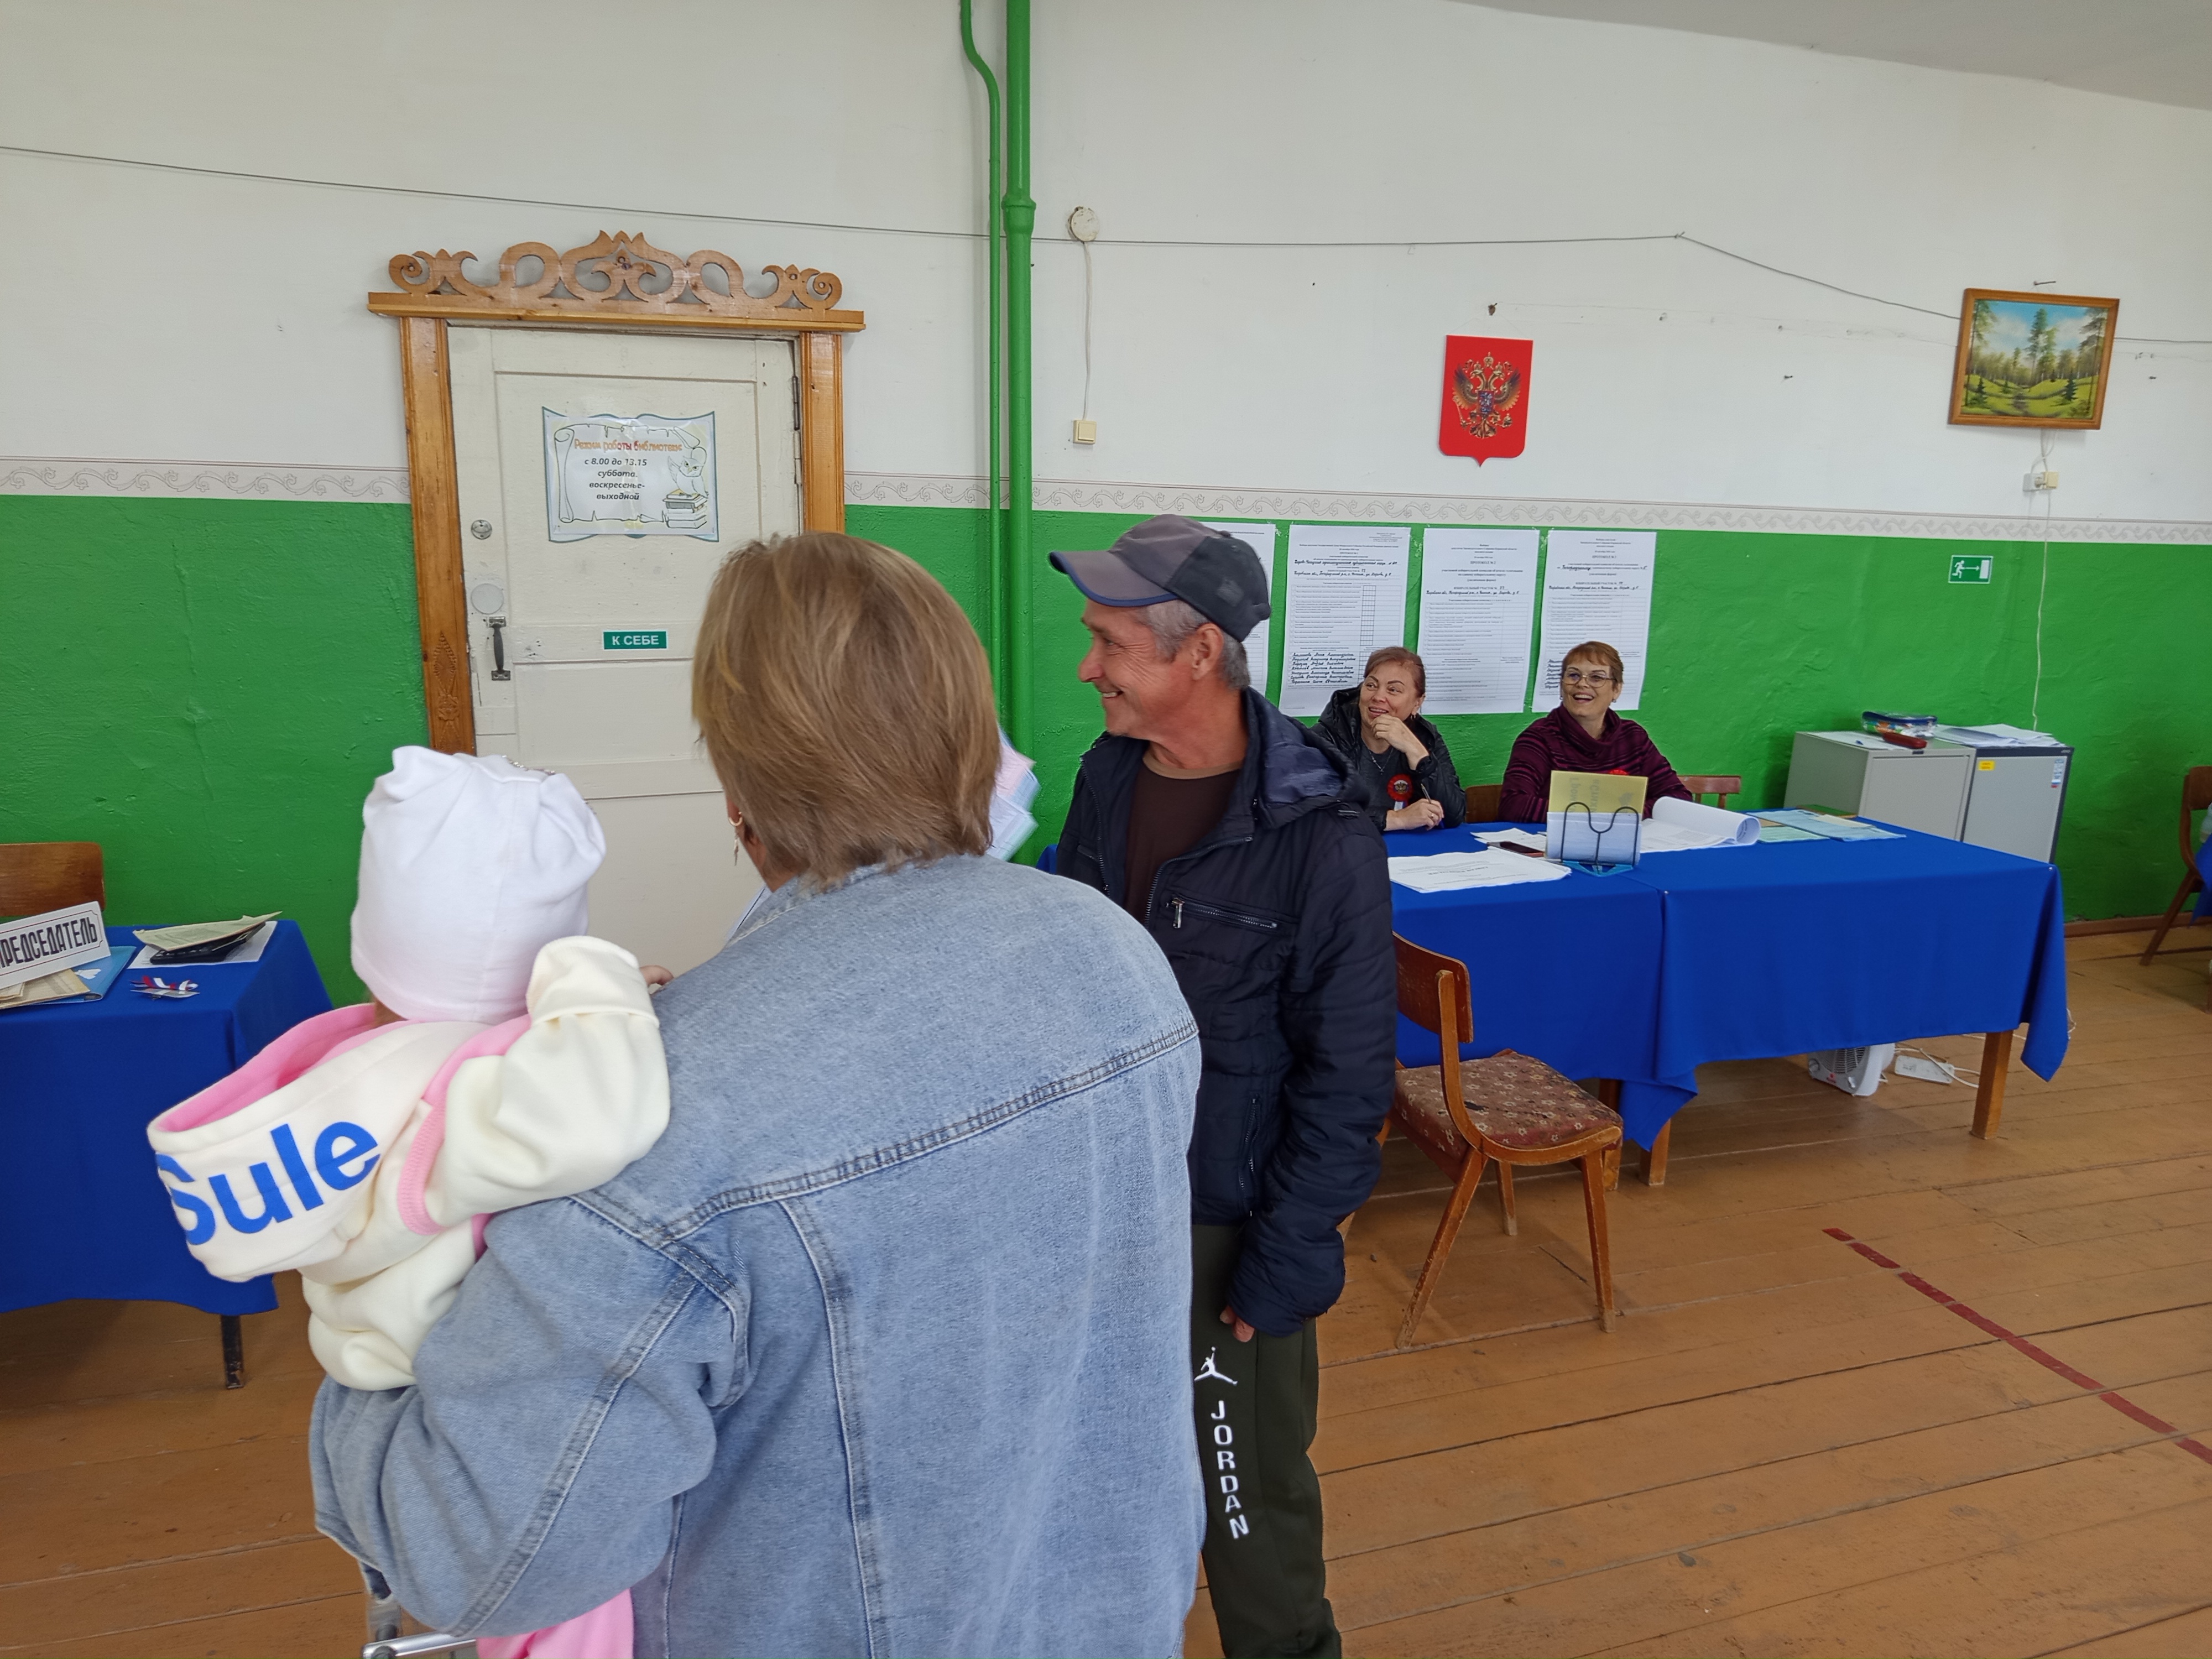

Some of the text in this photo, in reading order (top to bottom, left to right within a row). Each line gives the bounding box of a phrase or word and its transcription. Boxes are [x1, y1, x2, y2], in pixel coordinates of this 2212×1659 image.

[603, 439, 632, 453] работы
[612, 635, 659, 645] К СЕБЕ
[1211, 1400, 1250, 1539] JORDAN
